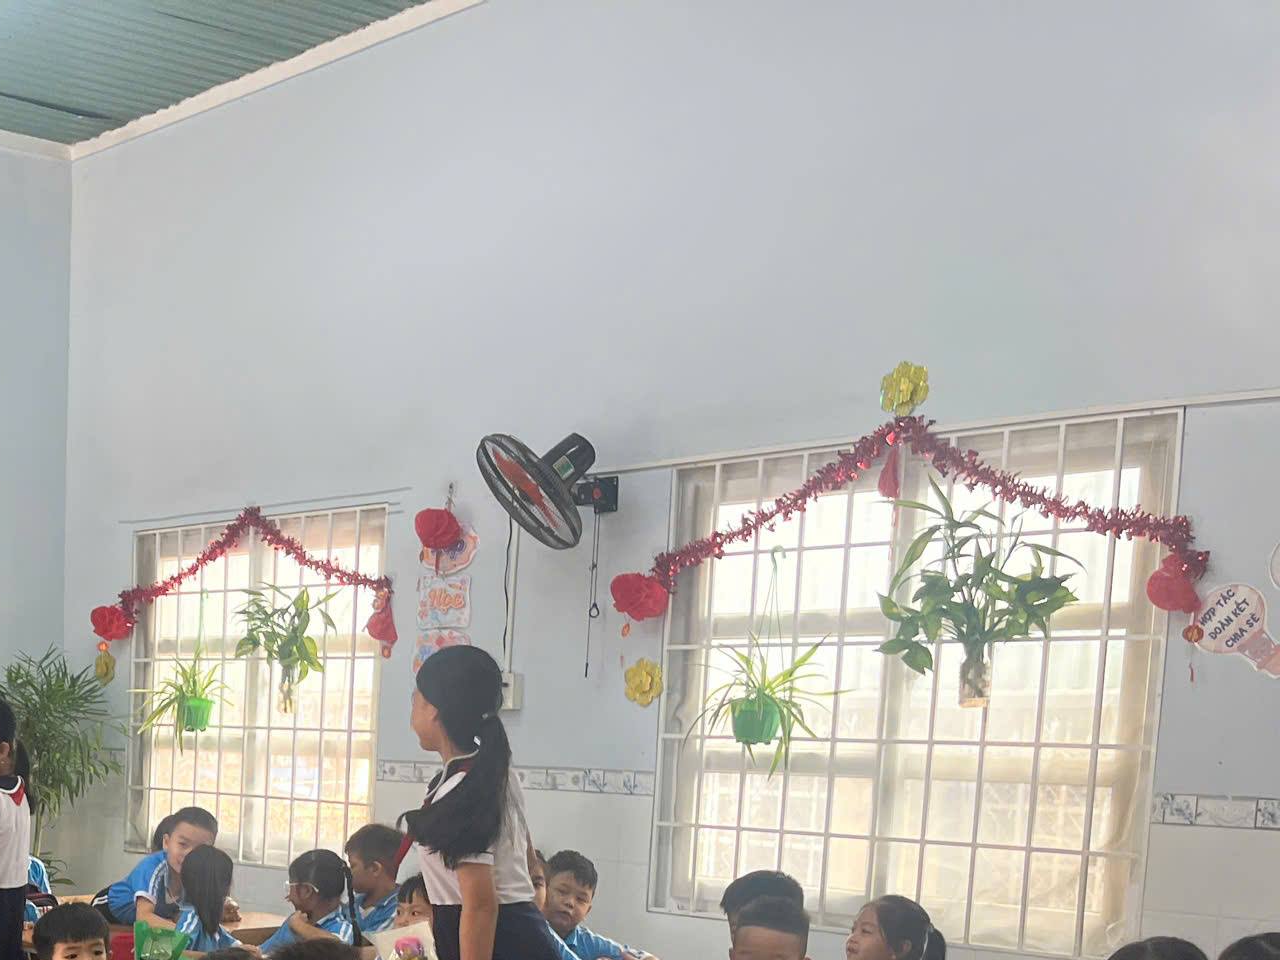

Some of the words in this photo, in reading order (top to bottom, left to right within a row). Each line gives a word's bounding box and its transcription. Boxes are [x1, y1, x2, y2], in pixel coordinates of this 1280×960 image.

[1200, 606, 1216, 626] HỢP
[1216, 588, 1236, 609] TÁC
[1231, 598, 1250, 619] KẾT
[1224, 628, 1248, 648] CHIA
